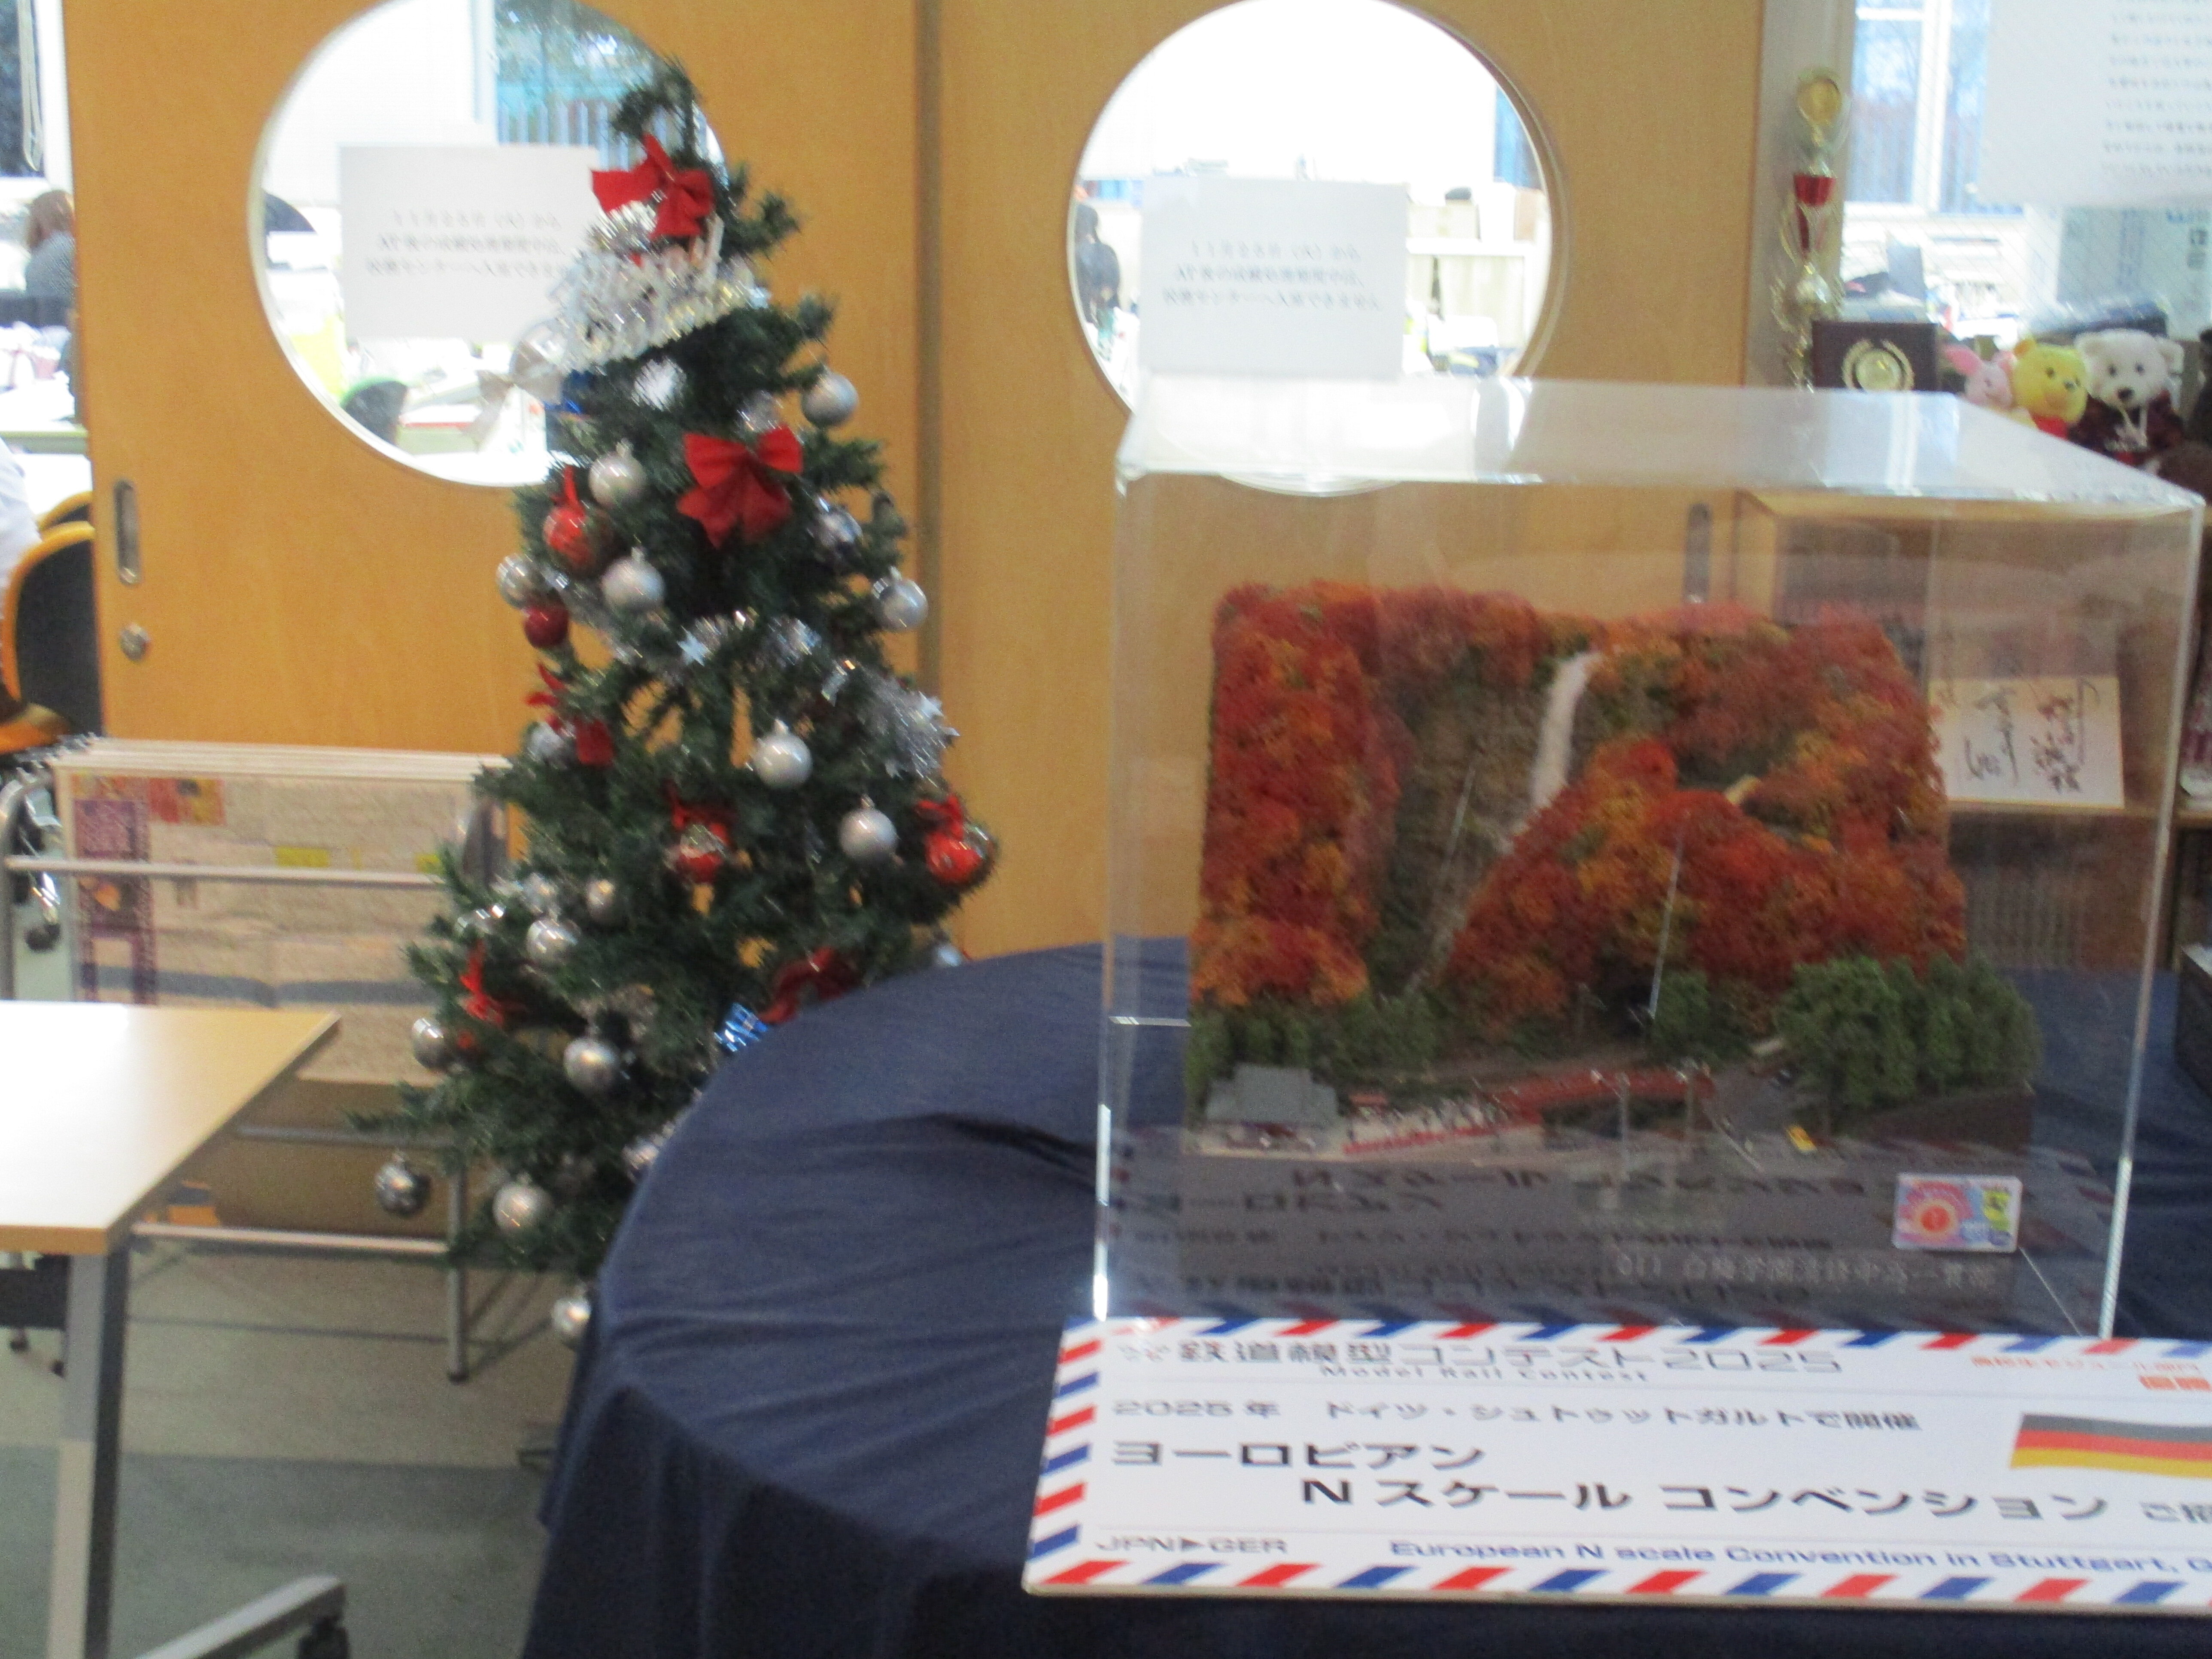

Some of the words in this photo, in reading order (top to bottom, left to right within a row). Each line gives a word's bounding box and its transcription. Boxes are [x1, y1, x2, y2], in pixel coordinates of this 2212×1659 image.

[1319, 1363, 1425, 1377] Model
[1390, 1540, 1565, 1559] European
[1576, 1542, 1604, 1559] N
[1613, 1545, 1715, 1562] scale
[1725, 1547, 1937, 1567] Convention
[1947, 1551, 1981, 1568] in
